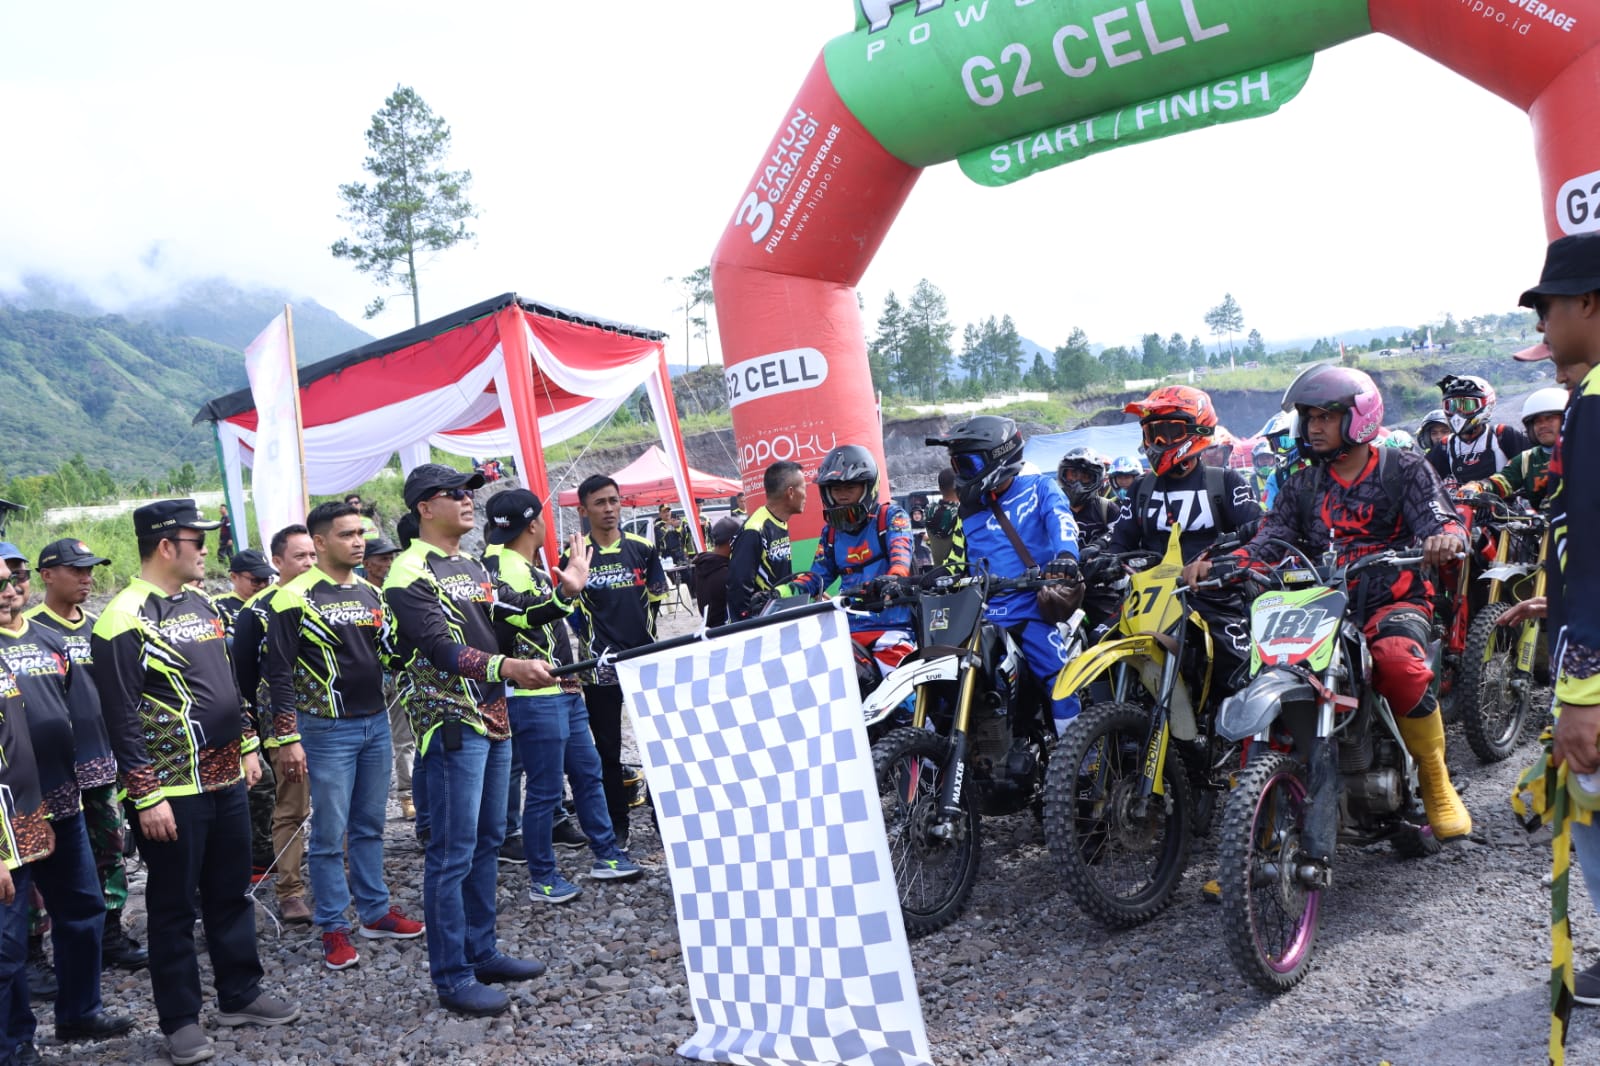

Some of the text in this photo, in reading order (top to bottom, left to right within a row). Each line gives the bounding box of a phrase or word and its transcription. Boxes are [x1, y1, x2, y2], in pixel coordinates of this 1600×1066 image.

[1461, 0, 1531, 36] ippo.id
[1508, 0, 1577, 32] VERAGE
[961, 0, 1230, 106] G2 CELL
[990, 119, 1100, 174] START
[1136, 71, 1271, 131] FINISH
[756, 108, 807, 191] TAHUN
[768, 117, 820, 203] GARANSI
[765, 228, 785, 253] FULL
[780, 178, 811, 228] DAMAGED
[807, 124, 841, 179] COVERAGE
[790, 155, 842, 241] www.hippo.id
[735, 191, 775, 244] 3
[745, 356, 819, 393] CELL
[1127, 586, 1163, 619] 27
[1260, 608, 1328, 643] 181
[1145, 730, 1162, 779] SHOWA
[952, 760, 965, 803] MAXXIS
